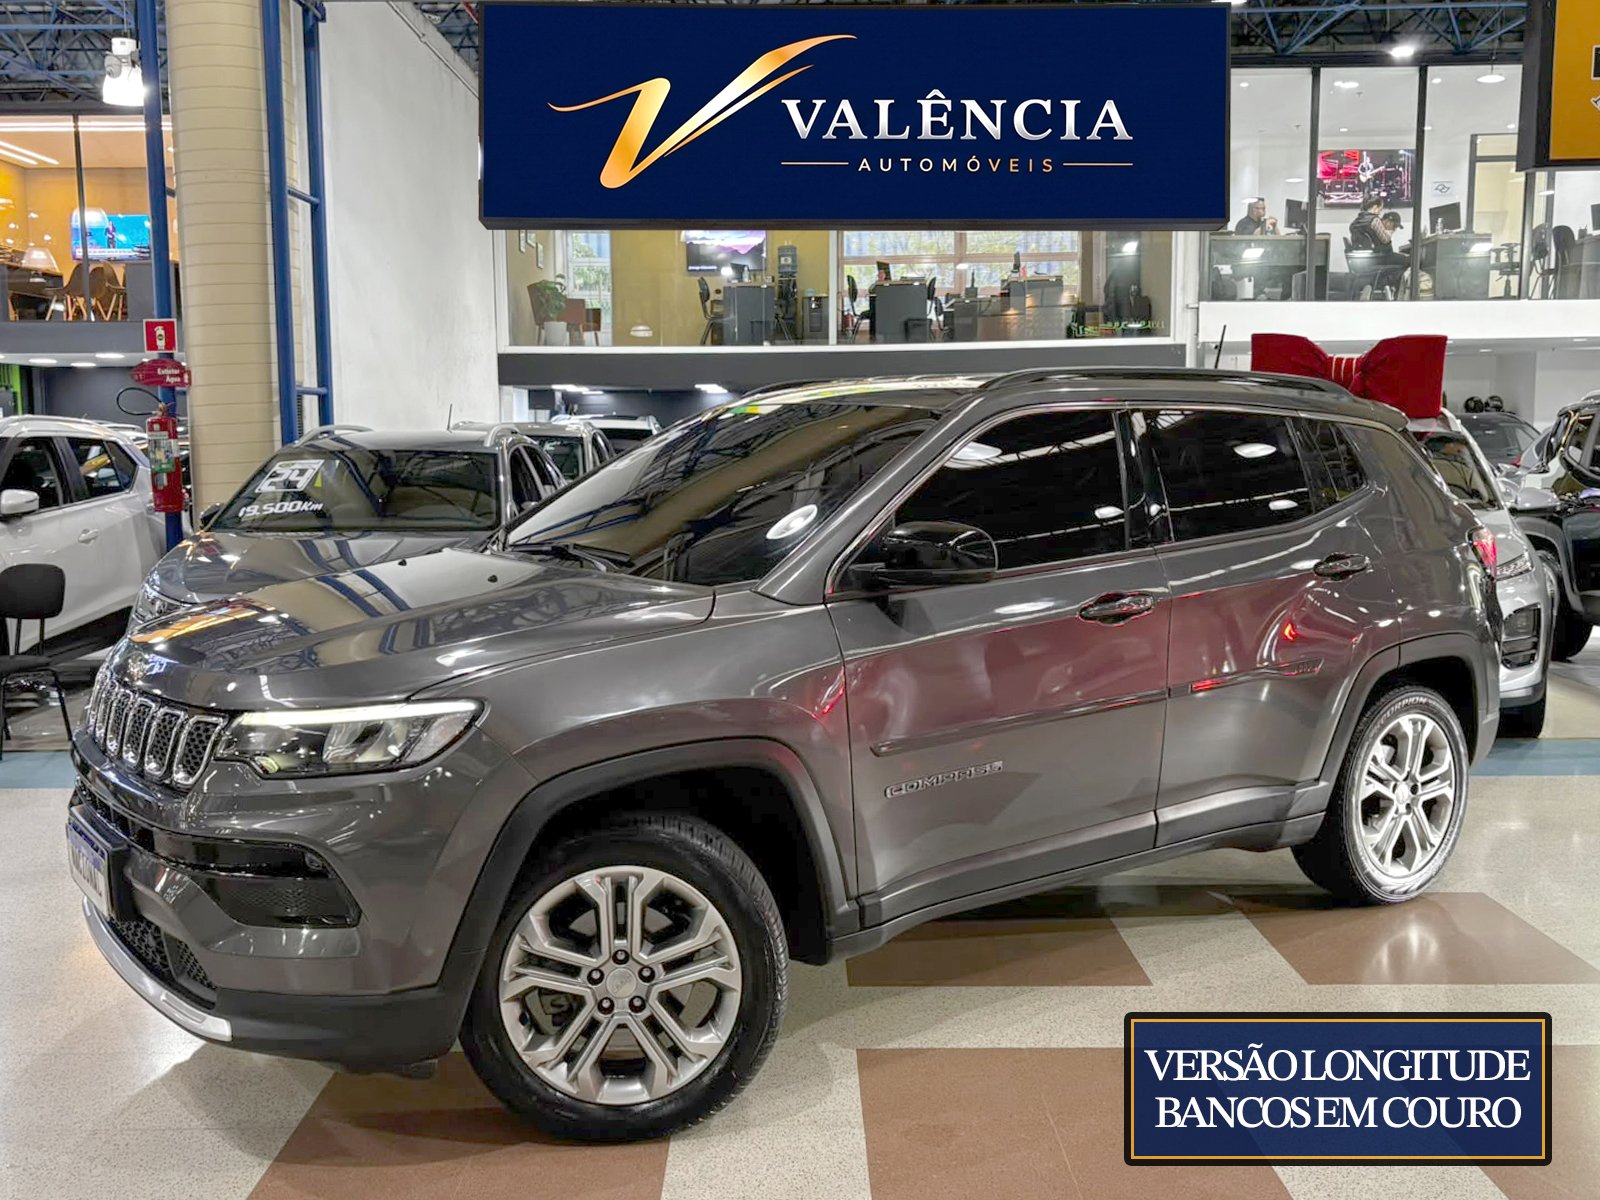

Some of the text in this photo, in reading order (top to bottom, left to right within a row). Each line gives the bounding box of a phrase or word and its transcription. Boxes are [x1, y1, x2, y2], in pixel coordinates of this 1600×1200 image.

[781, 88, 1134, 141] VALÊNCIA
[858, 155, 1053, 173] AUTOMÓVEIS
[262, 468, 314, 490] 24
